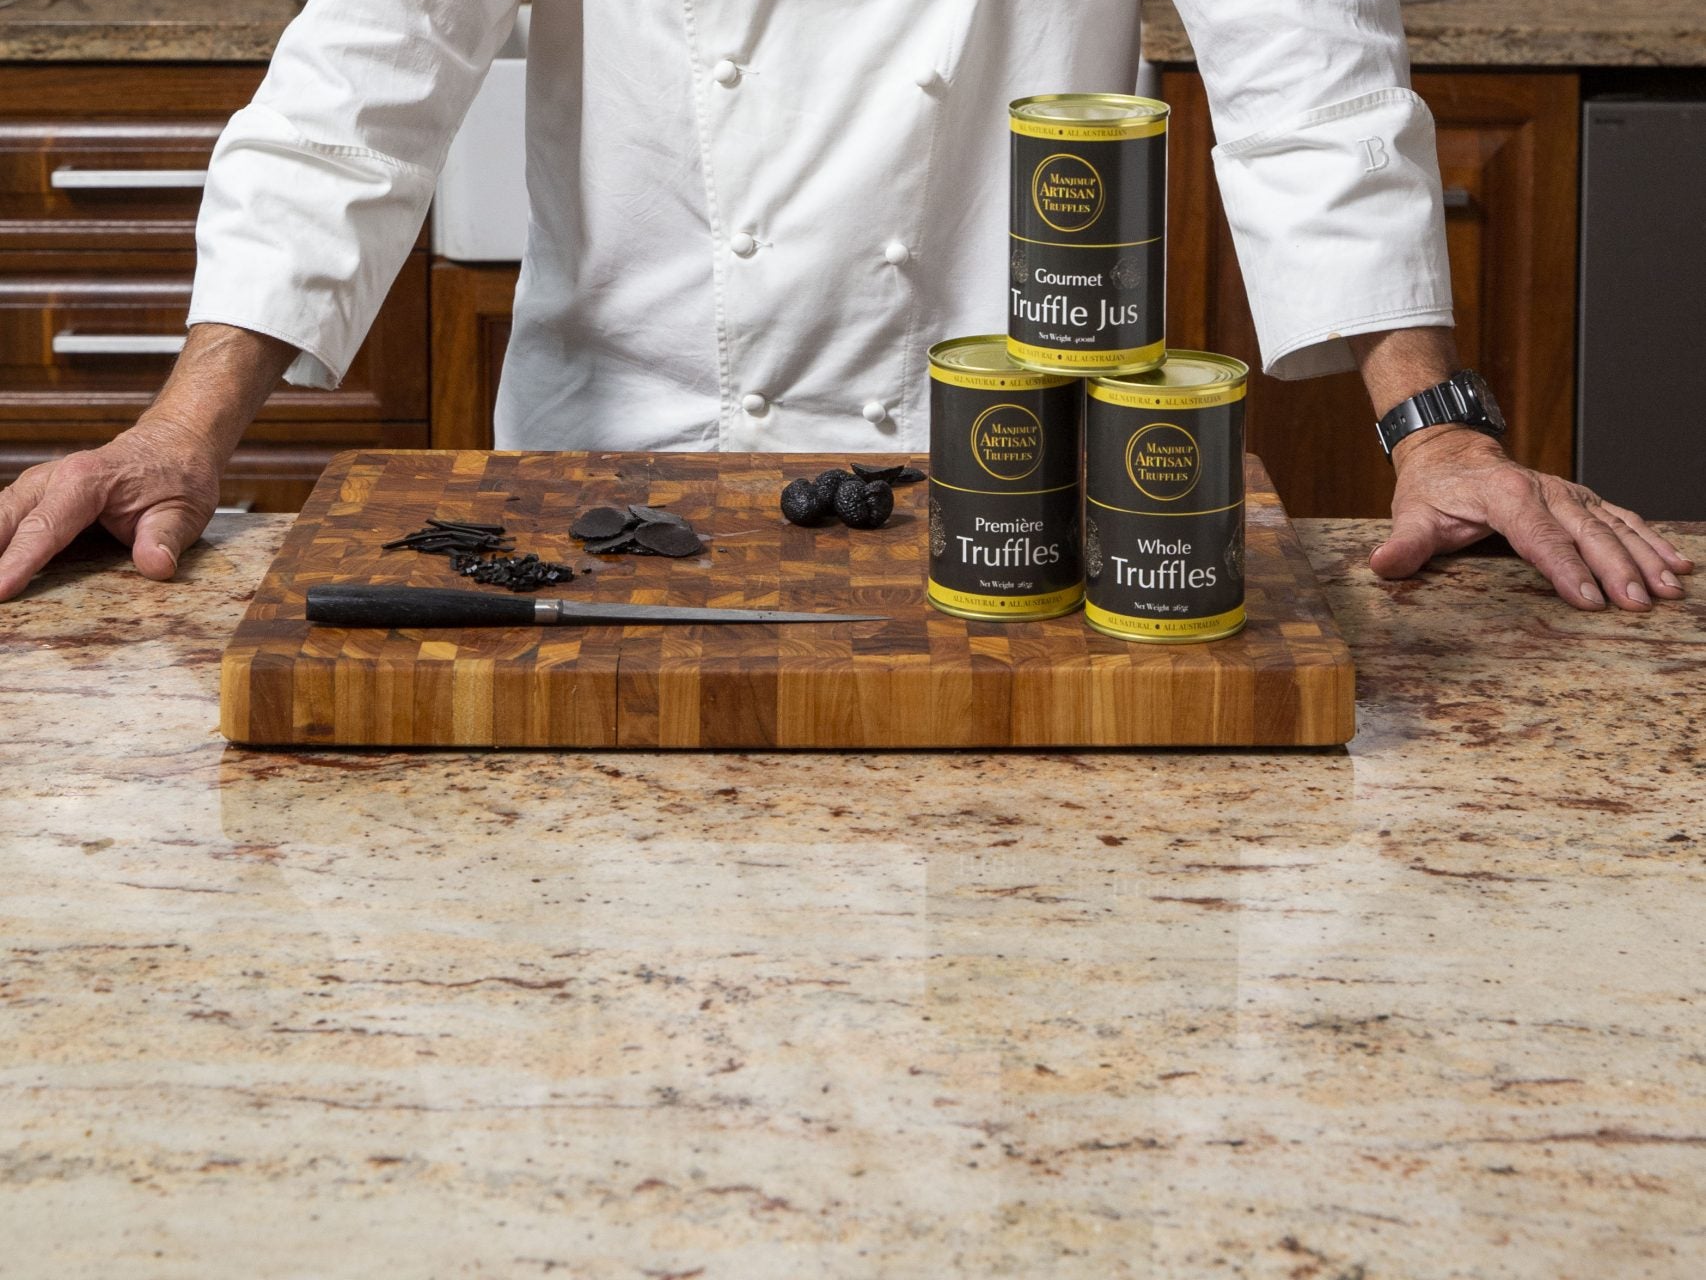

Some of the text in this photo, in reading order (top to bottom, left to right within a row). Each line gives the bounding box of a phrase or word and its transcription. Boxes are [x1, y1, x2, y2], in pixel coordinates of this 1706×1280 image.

[1083, 129, 1127, 137] AUSTRALIAN
[1357, 136, 1390, 173] B
[1050, 173, 1096, 187] MANJIMUP
[1040, 182, 1095, 199] ARTISAN
[1042, 199, 1091, 212] TRUFFLES
[1035, 268, 1103, 286] Gourmet
[1011, 288, 1138, 331] Truffle Jus
[1038, 332, 1095, 344] Net Weight 400ml
[963, 376, 996, 386] NATURAL
[1010, 379, 1022, 387] ALL
[1180, 395, 1221, 405] AUSTRALIAN
[992, 424, 1037, 435] MANJIMUP
[980, 432, 1037, 447] ARTISAN
[983, 448, 1033, 461] TRUFFLES
[1146, 442, 1194, 455] MANJIMUP
[1135, 452, 1193, 468] ARTISAN
[1138, 469, 1188, 481] TRUFFLES
[975, 517, 1044, 533] Première
[956, 535, 1060, 567] Truffles
[1137, 538, 1192, 555] Whole
[1111, 556, 1217, 589] Truffles
[980, 580, 990, 588] Net
[991, 580, 1014, 590] Weight
[963, 597, 996, 607] NATURAL
[1009, 600, 1023, 608] ALL
[1024, 595, 1063, 607] AUSTRALIAN
[1134, 601, 1145, 609] Net
[1146, 602, 1170, 612] Weight
[1119, 618, 1151, 630] NATURAL
[1180, 619, 1220, 631] AUSTRALIAN
